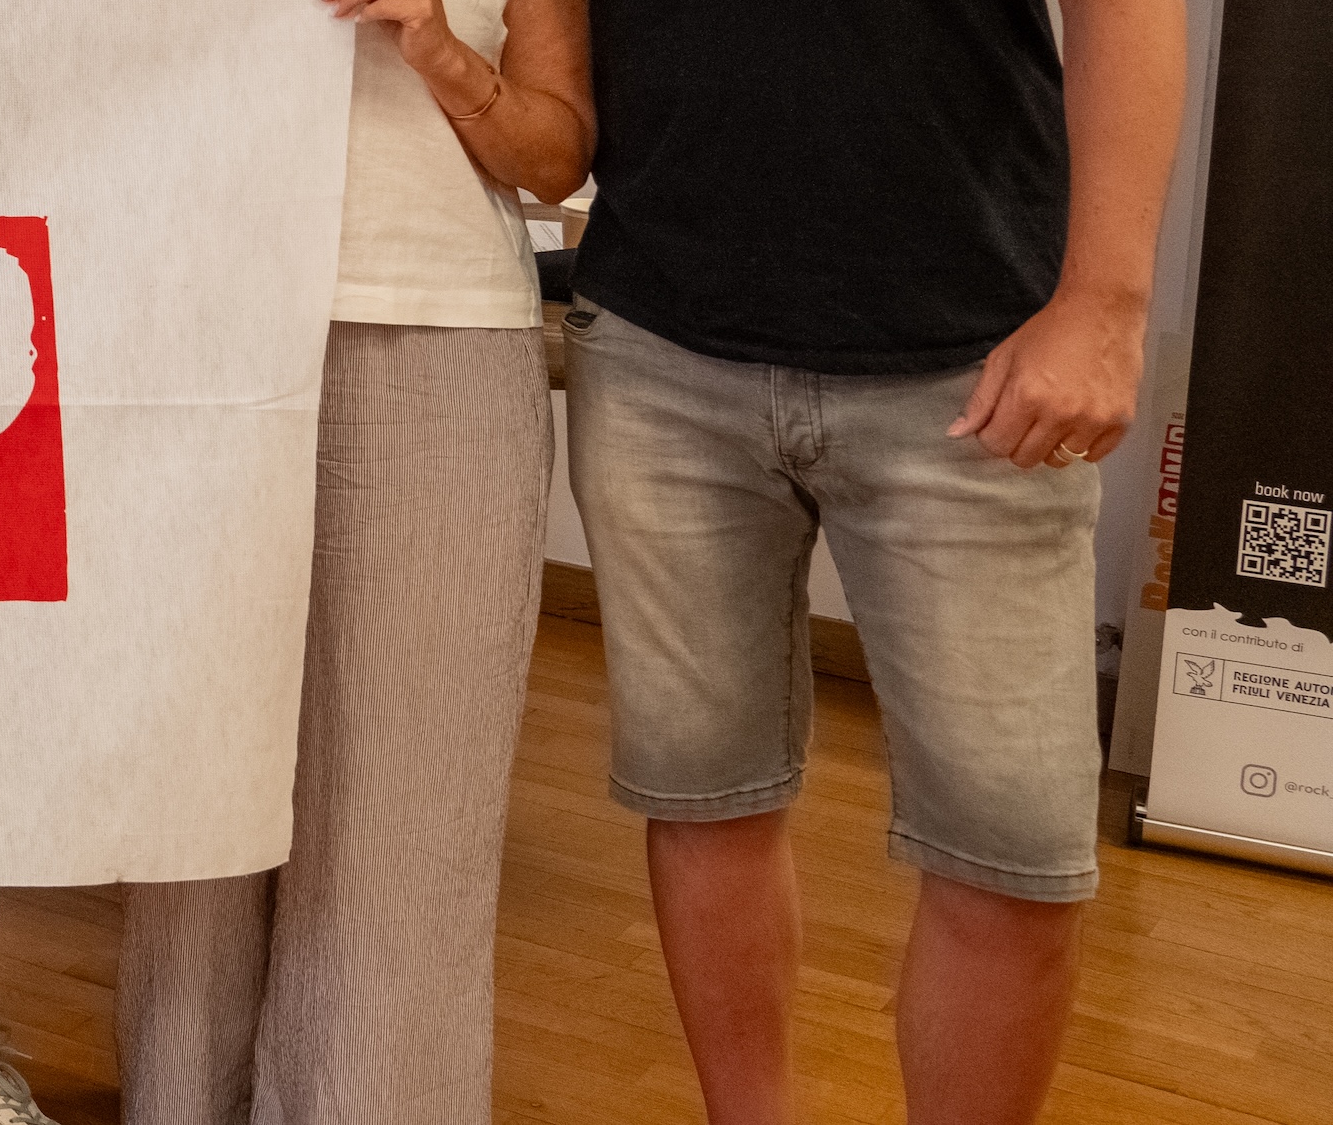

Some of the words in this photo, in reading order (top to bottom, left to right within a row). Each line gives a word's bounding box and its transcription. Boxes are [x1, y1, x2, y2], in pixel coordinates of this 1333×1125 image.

[1255, 481, 1289, 499] book
[1293, 490, 1324, 503] now
[1182, 627, 1208, 639] con
[1211, 629, 1217, 640] il
[1220, 632, 1288, 650] contributo
[1291, 642, 1304, 653] di
[1233, 671, 1289, 689] REGIONE
[1294, 681, 1333, 696] AUTO
[1232, 684, 1271, 699] FRIULI
[1276, 690, 1330, 708] VENEZIA
